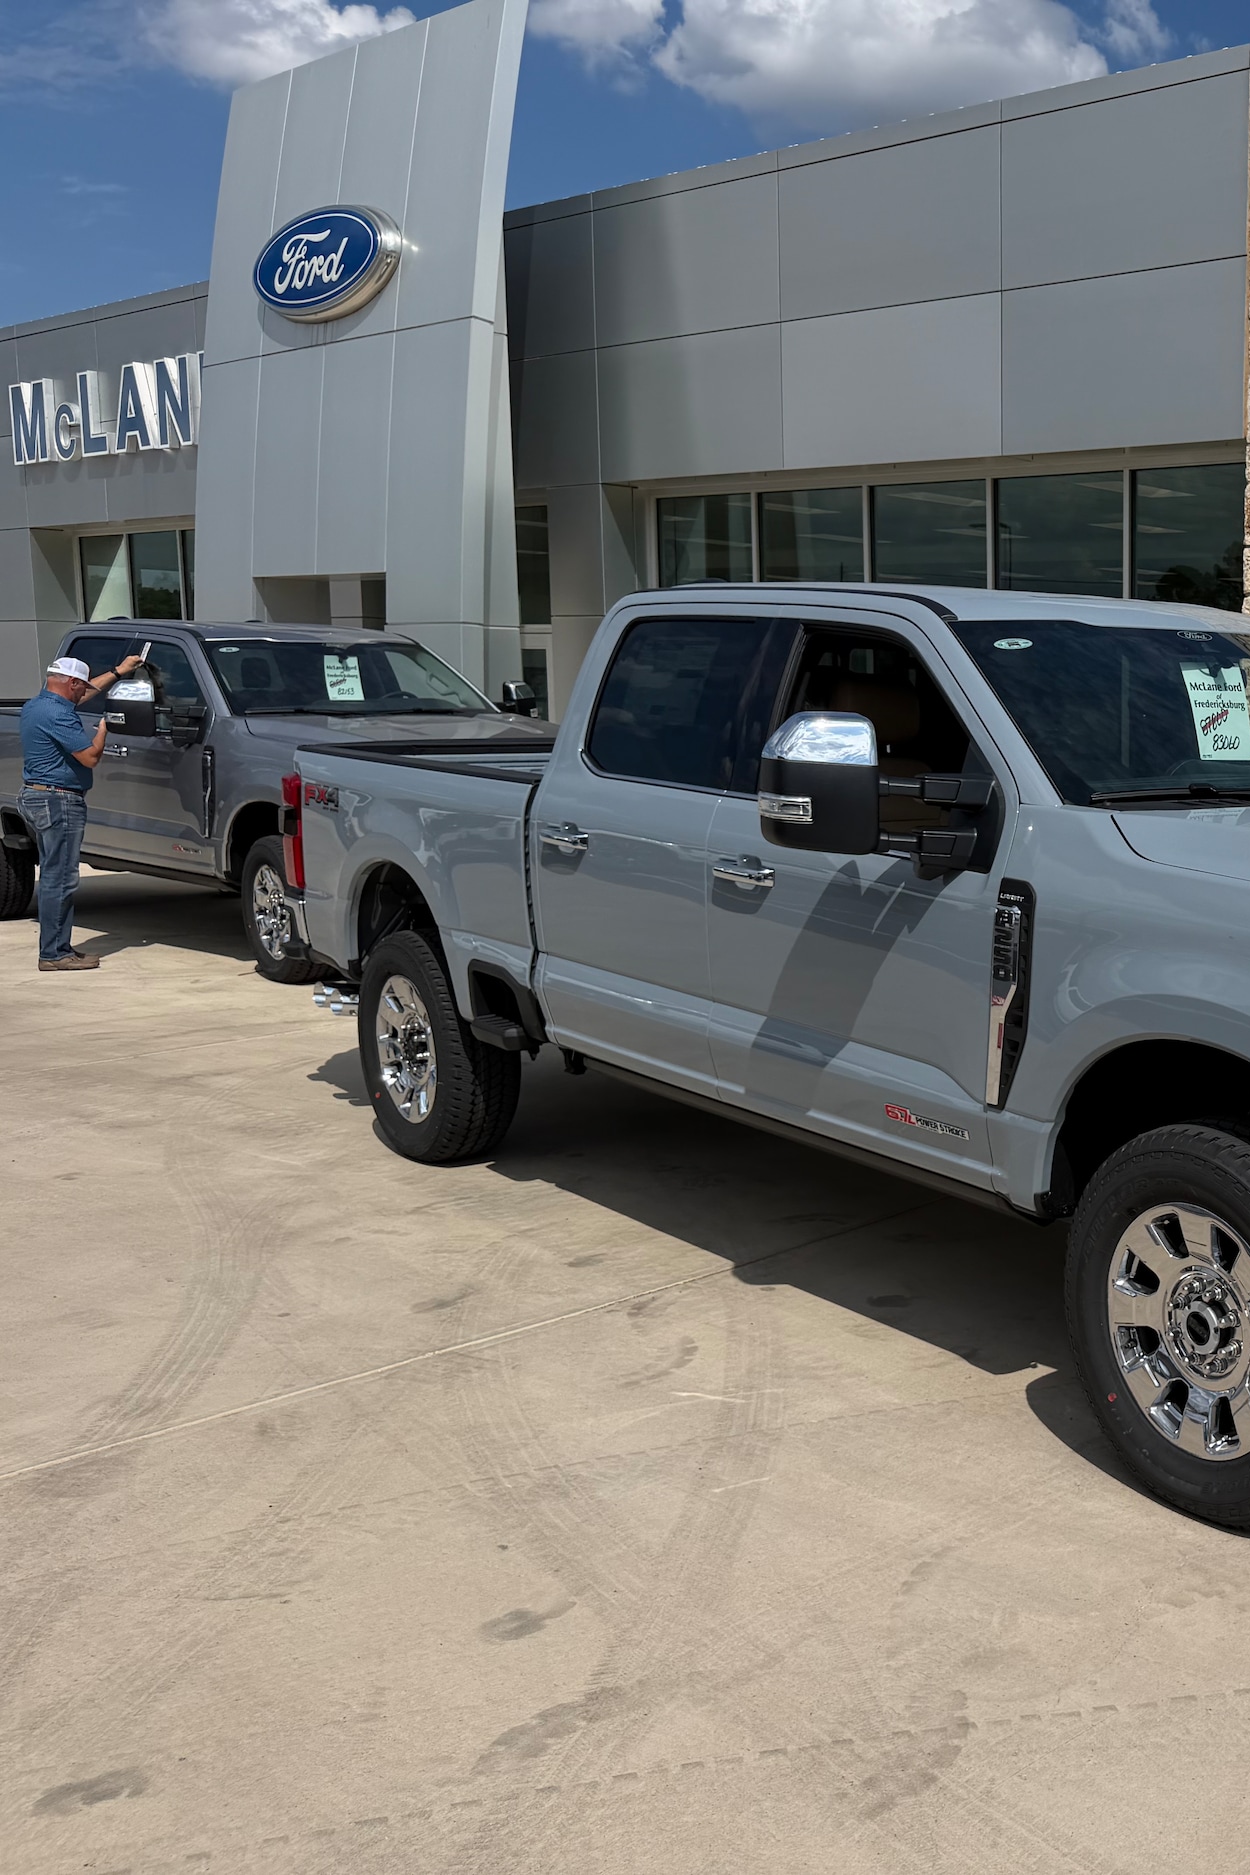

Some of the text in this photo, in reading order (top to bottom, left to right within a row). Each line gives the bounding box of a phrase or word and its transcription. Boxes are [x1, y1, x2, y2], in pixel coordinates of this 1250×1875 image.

[274, 229, 348, 294] Ford
[8, 350, 205, 465] McLAN
[1189, 682, 1242, 692] McLane Ford
[1194, 700, 1245, 711] Fredericksburg
[1213, 734, 1241, 751] 83060
[305, 784, 339, 807] FX4
[915, 1117, 939, 1130] POWER
[940, 1124, 967, 1139] STROKE
